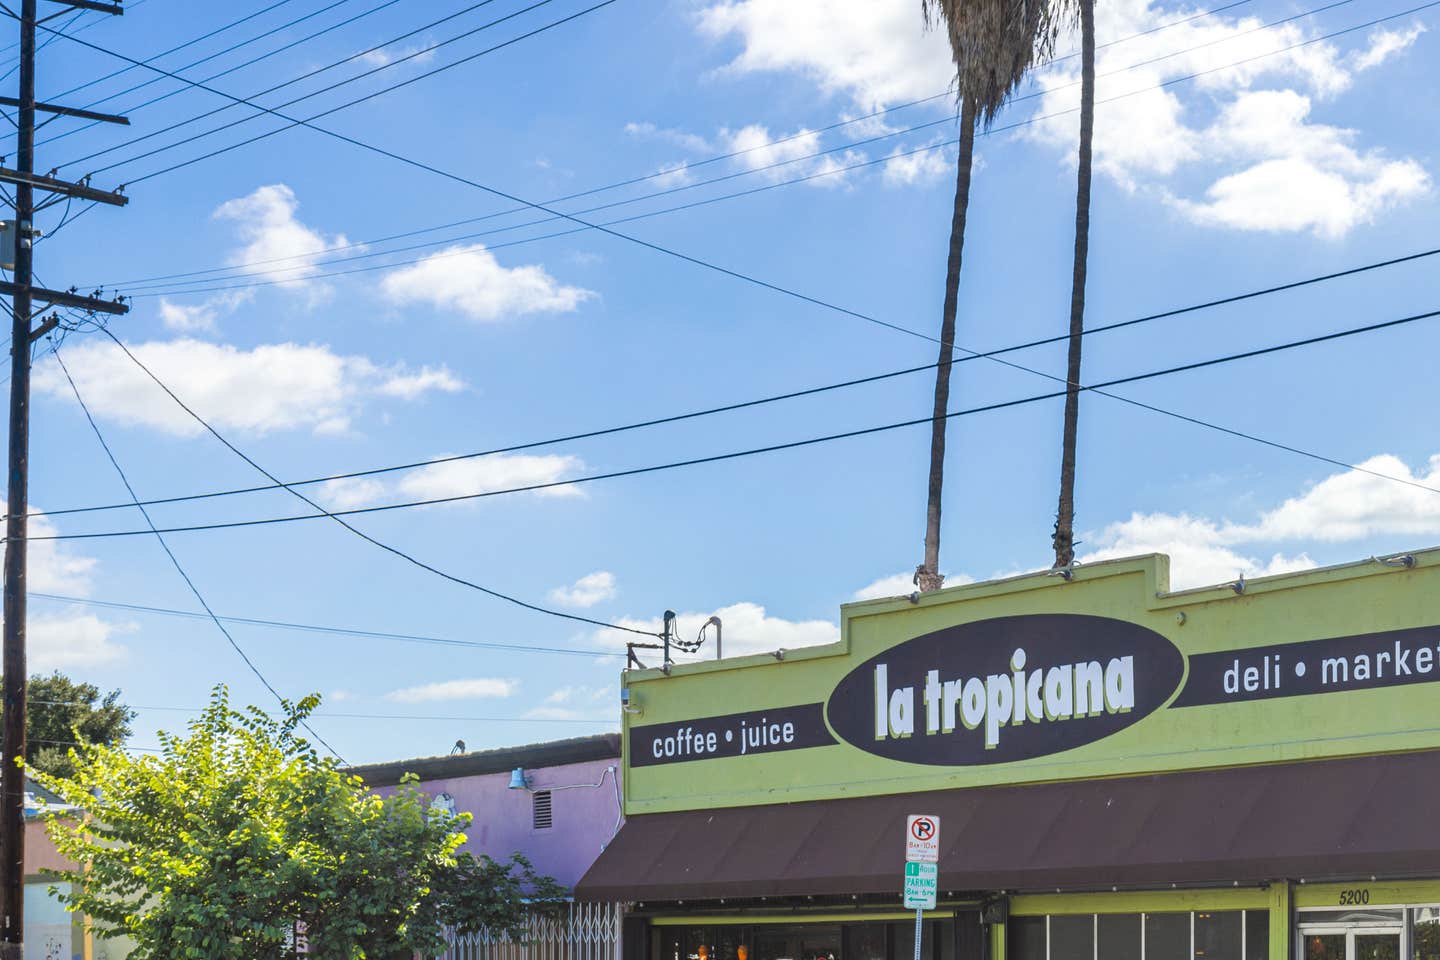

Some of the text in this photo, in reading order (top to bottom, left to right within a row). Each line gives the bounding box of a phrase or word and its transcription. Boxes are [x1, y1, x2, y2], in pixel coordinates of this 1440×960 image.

[1223, 654, 1281, 694] deli
[873, 648, 1135, 750] la tropicana
[653, 718, 794, 759] coffee juice
[906, 878, 935, 888] PARKING
[1339, 888, 1369, 906] 5200
